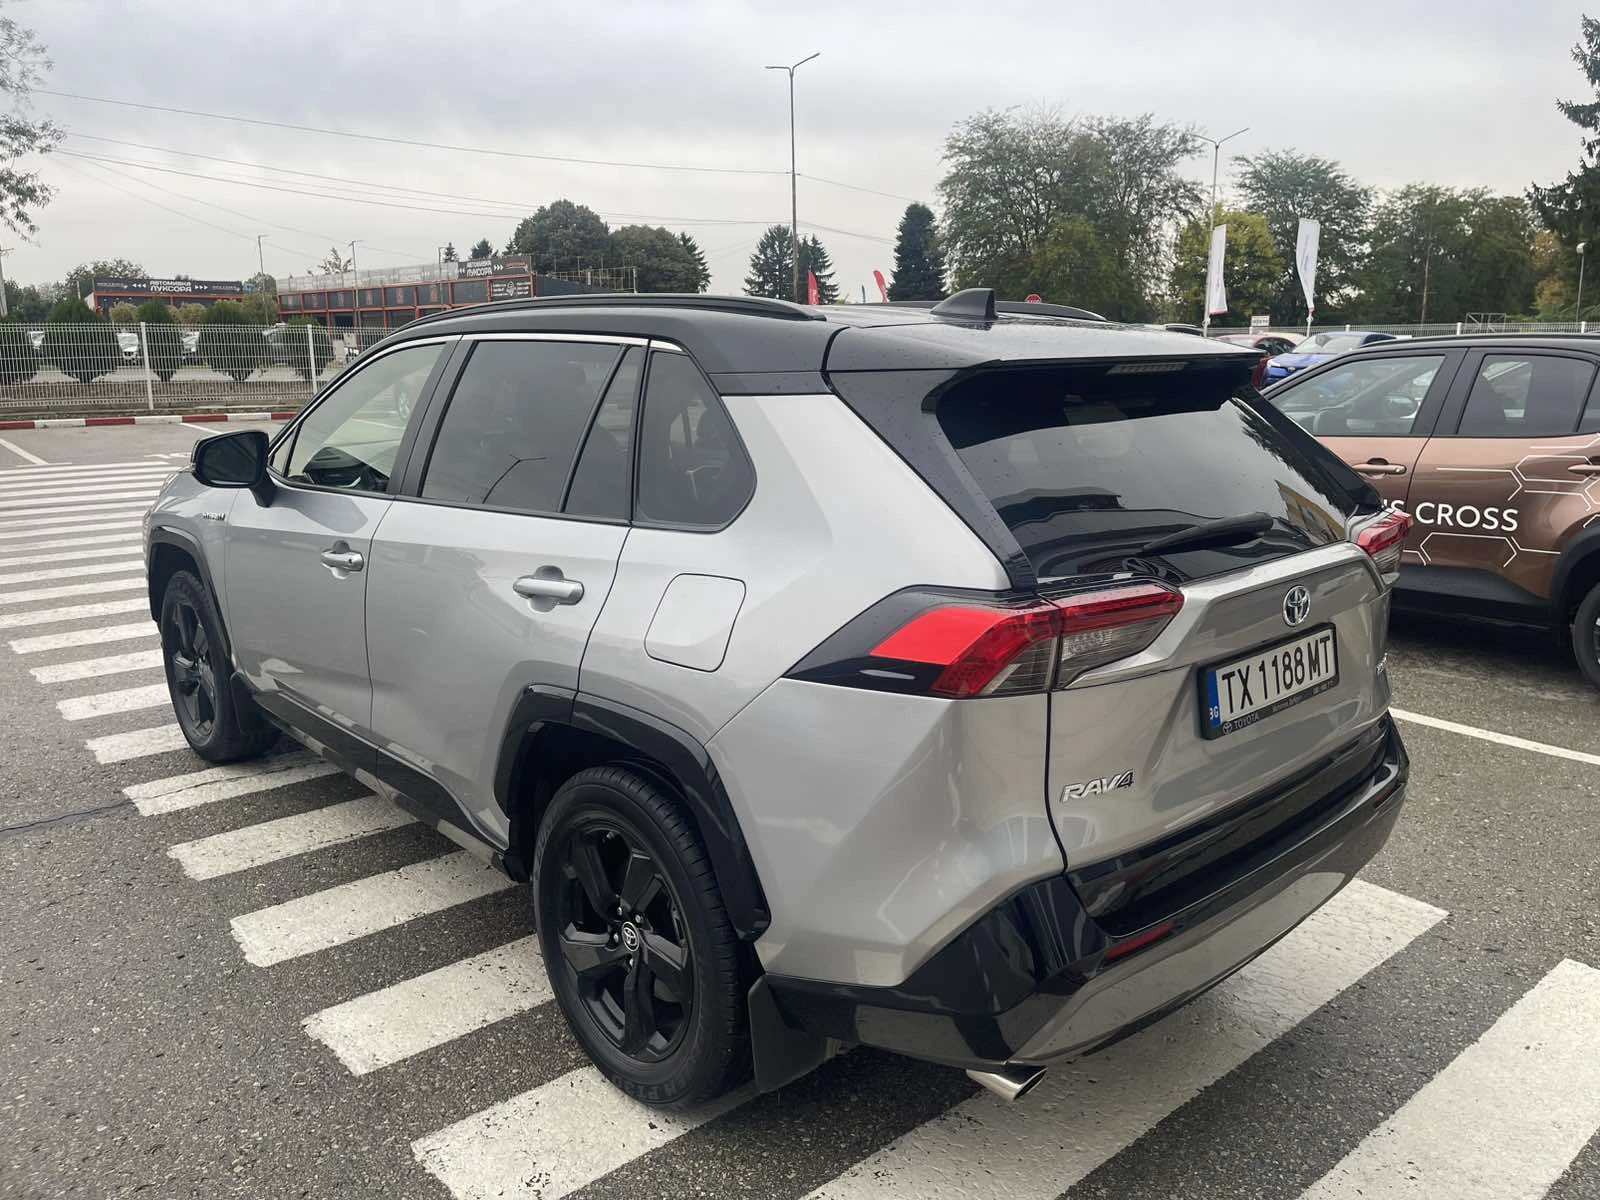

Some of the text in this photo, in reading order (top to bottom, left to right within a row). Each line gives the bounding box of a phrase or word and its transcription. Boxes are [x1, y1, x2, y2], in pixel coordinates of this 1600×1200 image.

[1415, 502, 1519, 532] CROSS
[1222, 665, 1253, 714] TX
[1259, 648, 1305, 700] 1188
[1307, 635, 1331, 681] MT
[1233, 712, 1260, 729] TOYOTA
[1059, 769, 1134, 803] RAV4
